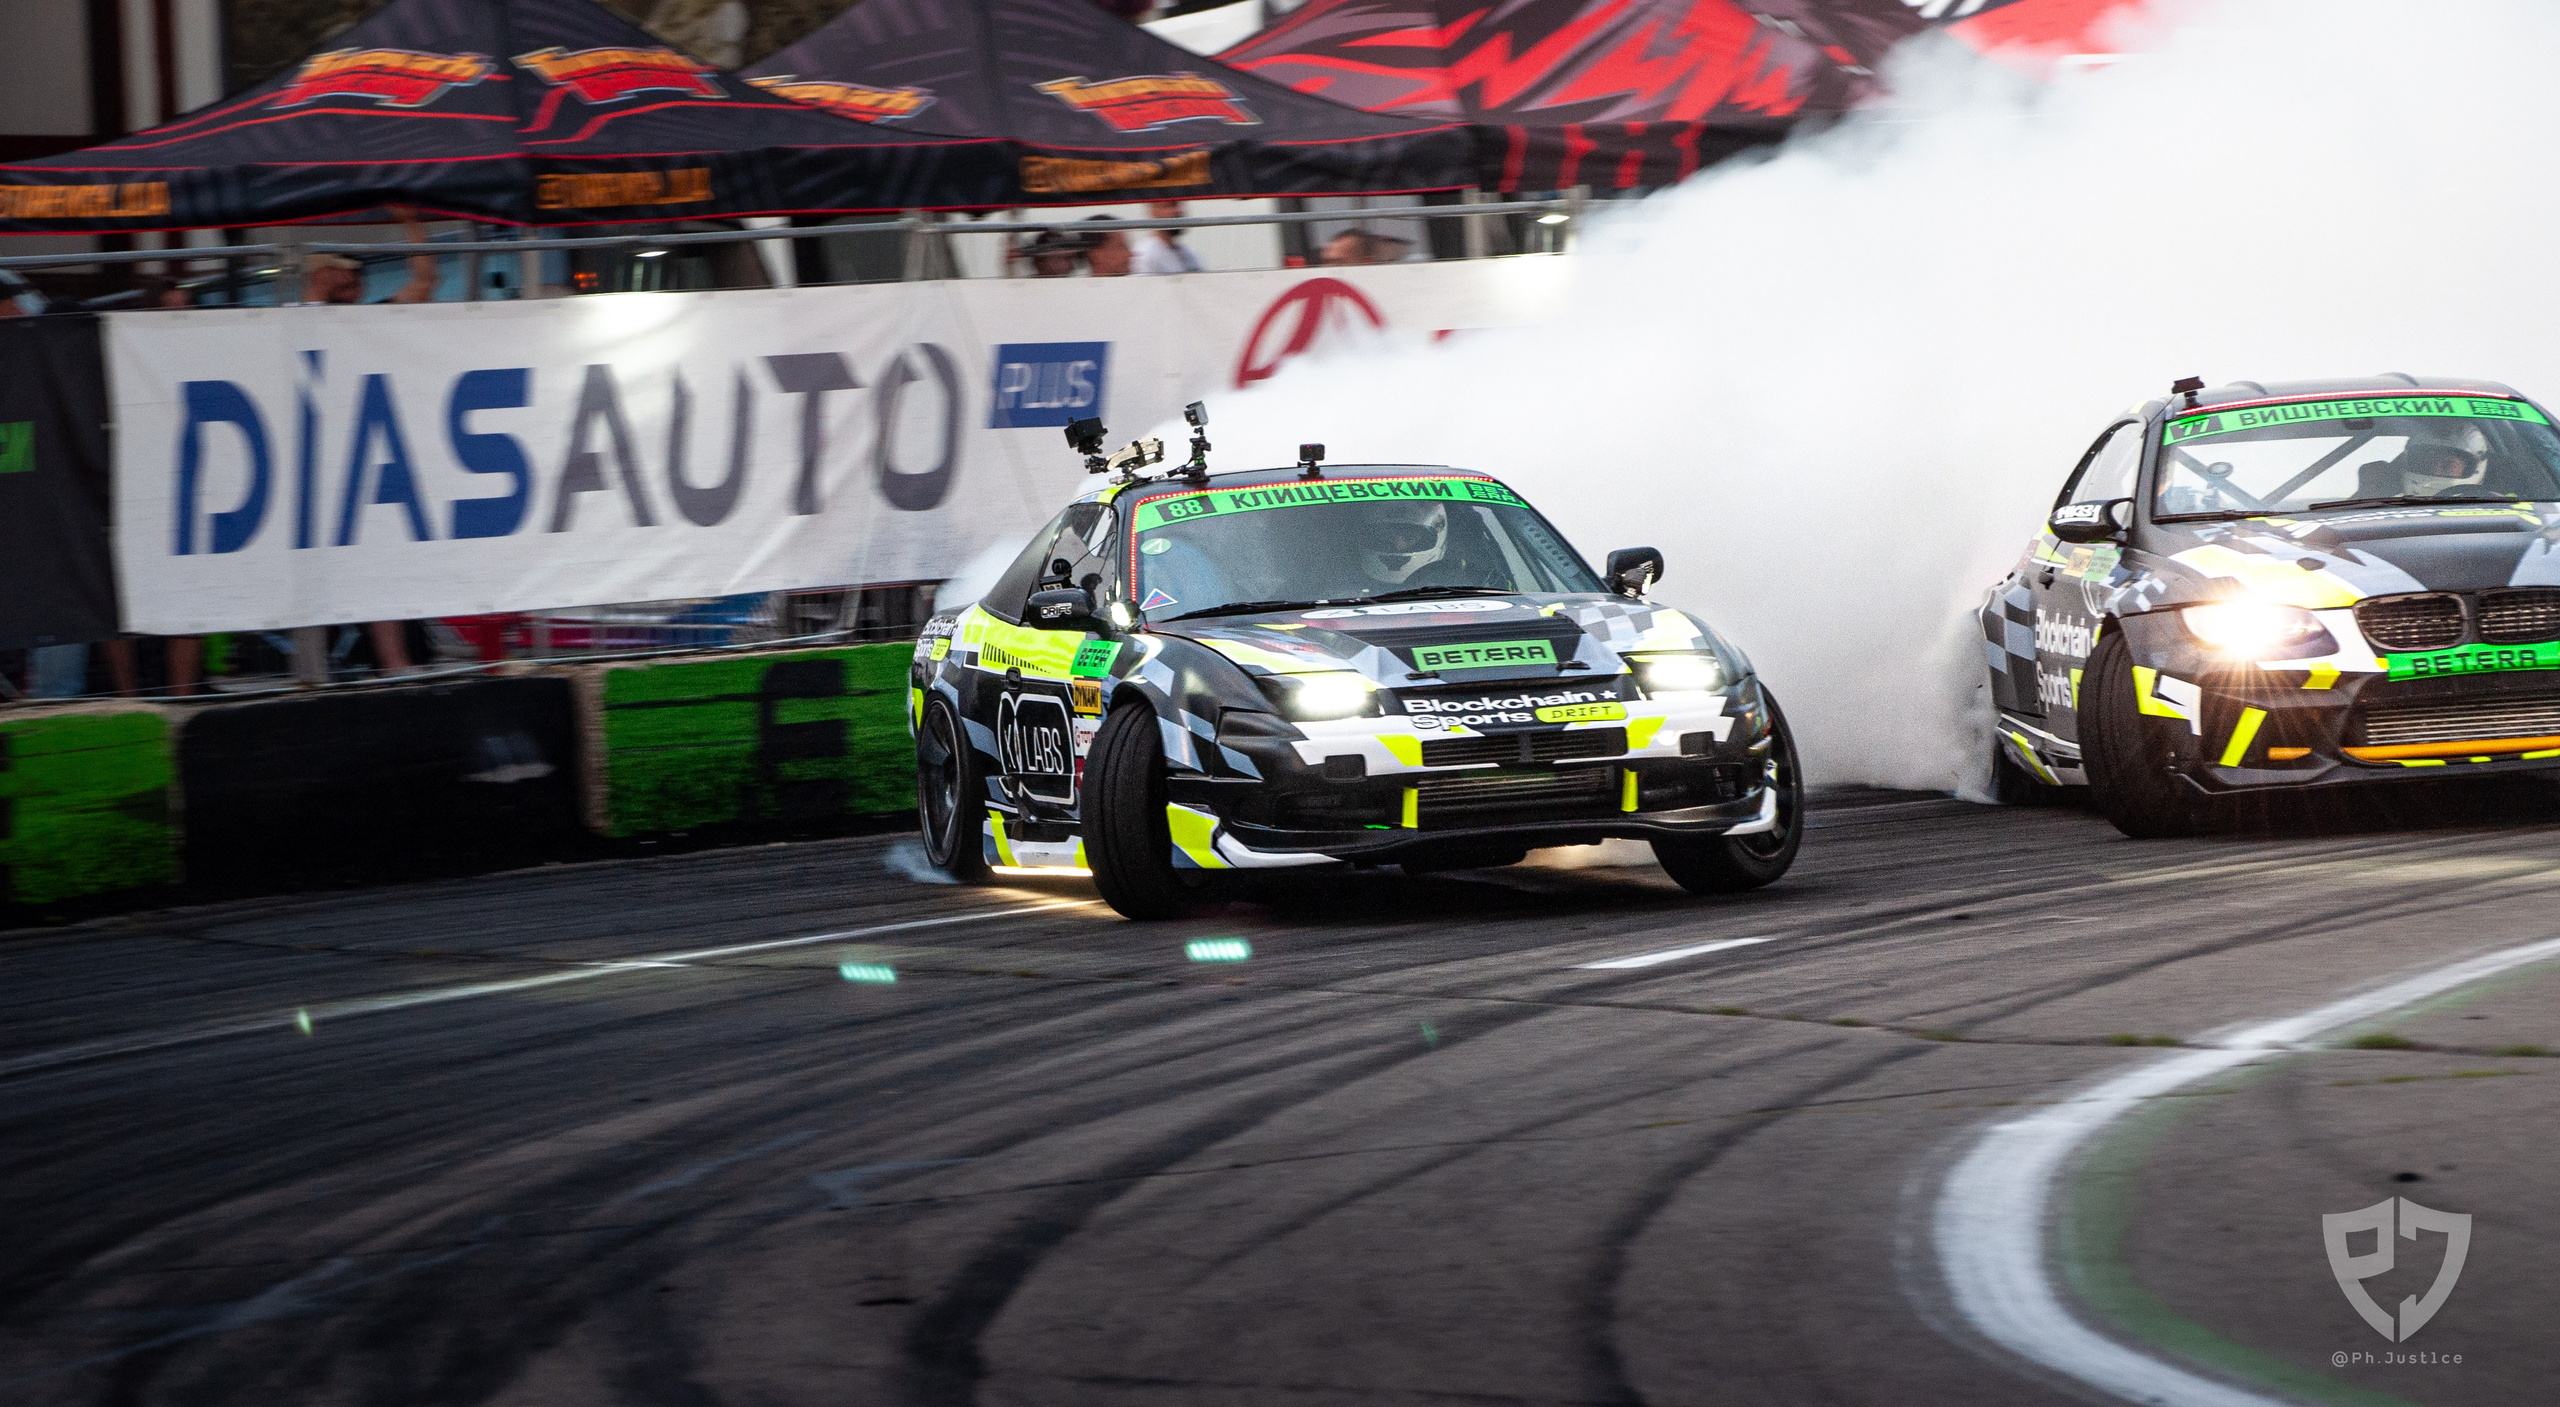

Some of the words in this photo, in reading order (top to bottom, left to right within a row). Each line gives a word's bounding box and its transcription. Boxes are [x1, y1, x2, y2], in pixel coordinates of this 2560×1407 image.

[997, 360, 1098, 409] PLUS
[2178, 420, 2211, 437] 77
[2239, 397, 2455, 426] ВИШНЕВСКИЙ
[1168, 498, 1204, 519] 88
[2035, 608, 2091, 659] Blockchain
[1402, 691, 1597, 713] Blockchain
[1412, 711, 1533, 731] Sports
[1551, 705, 1613, 719] DRIFT
[1023, 725, 1065, 775] LABS
